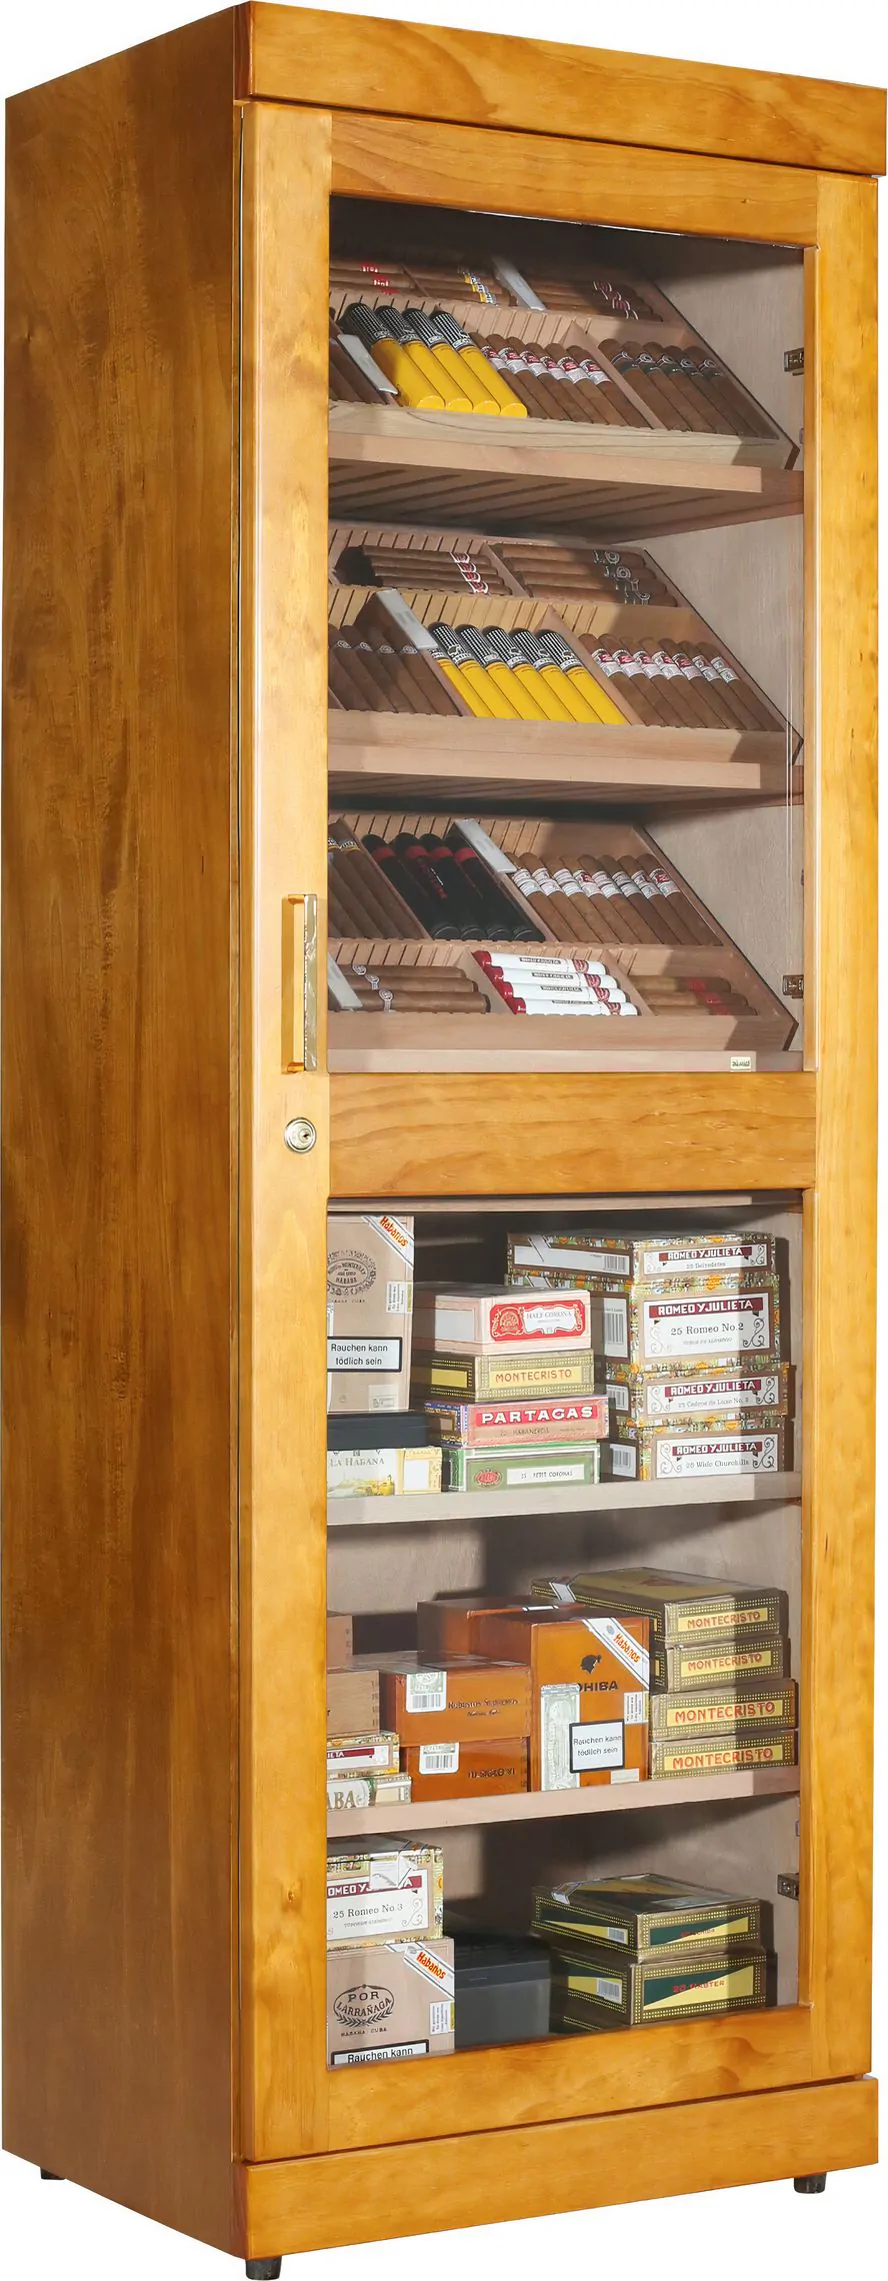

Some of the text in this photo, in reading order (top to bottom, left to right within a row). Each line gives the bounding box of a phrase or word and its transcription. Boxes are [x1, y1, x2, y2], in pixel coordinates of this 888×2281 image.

[379, 1216, 409, 1248] Habanos
[668, 1251, 698, 1261] ROMEO
[658, 1304, 695, 1316] ROMEO
[671, 1328, 683, 1336] 25
[686, 1325, 719, 1335] Romeo
[331, 1343, 388, 1353] Rauchen kann
[335, 1356, 382, 1367] tödlich sein
[495, 1368, 573, 1383] MONTECRISTO
[671, 1385, 704, 1396] ROMEO
[481, 1406, 593, 1424] PARTAGAS
[677, 1445, 708, 1455] ROMEO
[330, 1457, 385, 1467] LA HABANA
[687, 1610, 761, 1629] MONTECRISTO
[613, 1633, 641, 1664] Habanos
[687, 1653, 763, 1672] MONTECRISTO
[577, 1680, 618, 1692] HIBA
[674, 1701, 775, 1723] MONTECRISTO
[573, 1736, 604, 1745] Rauchen
[577, 1746, 618, 1756] tödlich sein
[672, 1747, 774, 1769] MONTECRISTO
[328, 1884, 357, 1897] OMEO
[333, 1910, 344, 1919] 25
[347, 1907, 379, 1918] Romeo
[416, 1951, 446, 1980] Habanos
[348, 1991, 380, 2002] POR
[336, 1997, 392, 2017] LARRAÑAGA
[347, 2047, 413, 2064] Rauchen kann
